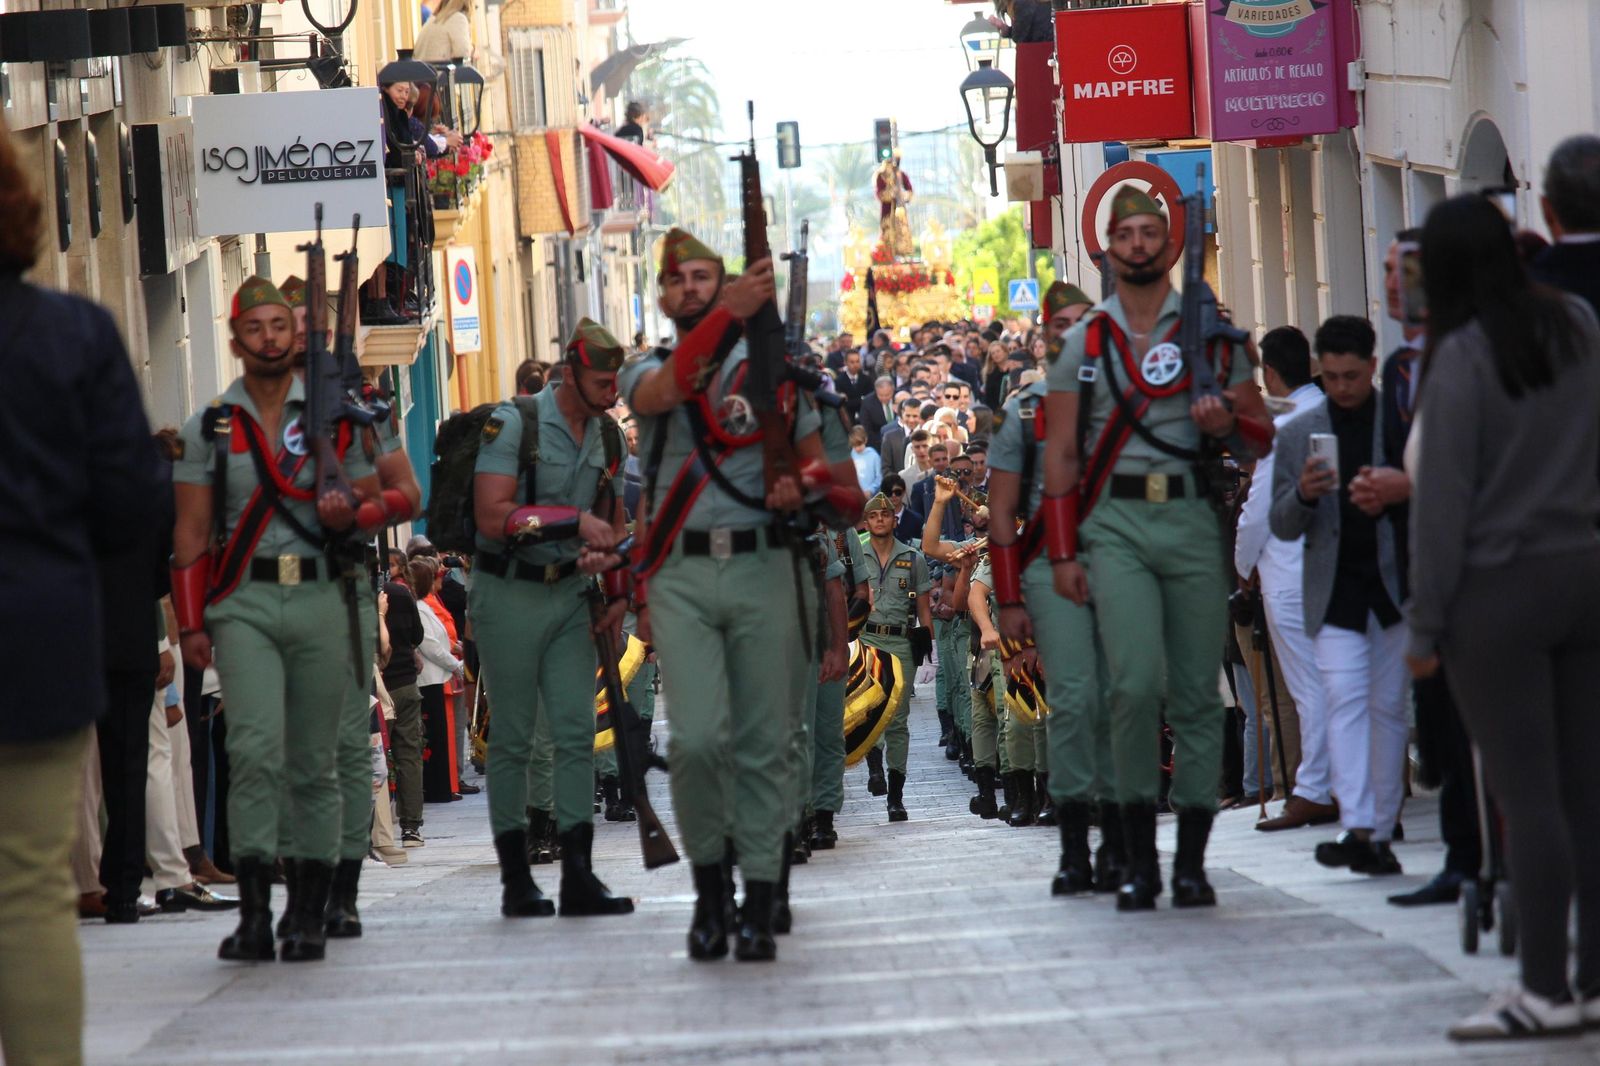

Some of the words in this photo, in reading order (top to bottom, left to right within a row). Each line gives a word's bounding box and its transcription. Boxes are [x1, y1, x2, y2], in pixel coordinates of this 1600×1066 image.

[1238, 5, 1301, 21] VARIEDADES
[1224, 65, 1272, 83] ARTÍCULOS
[1275, 65, 1286, 79] DE
[1289, 63, 1323, 78] REGALO
[1073, 79, 1175, 100] MAPFRE
[1225, 91, 1326, 112] MULTIPRECIO
[267, 167, 370, 181] PELUQUERÍA
